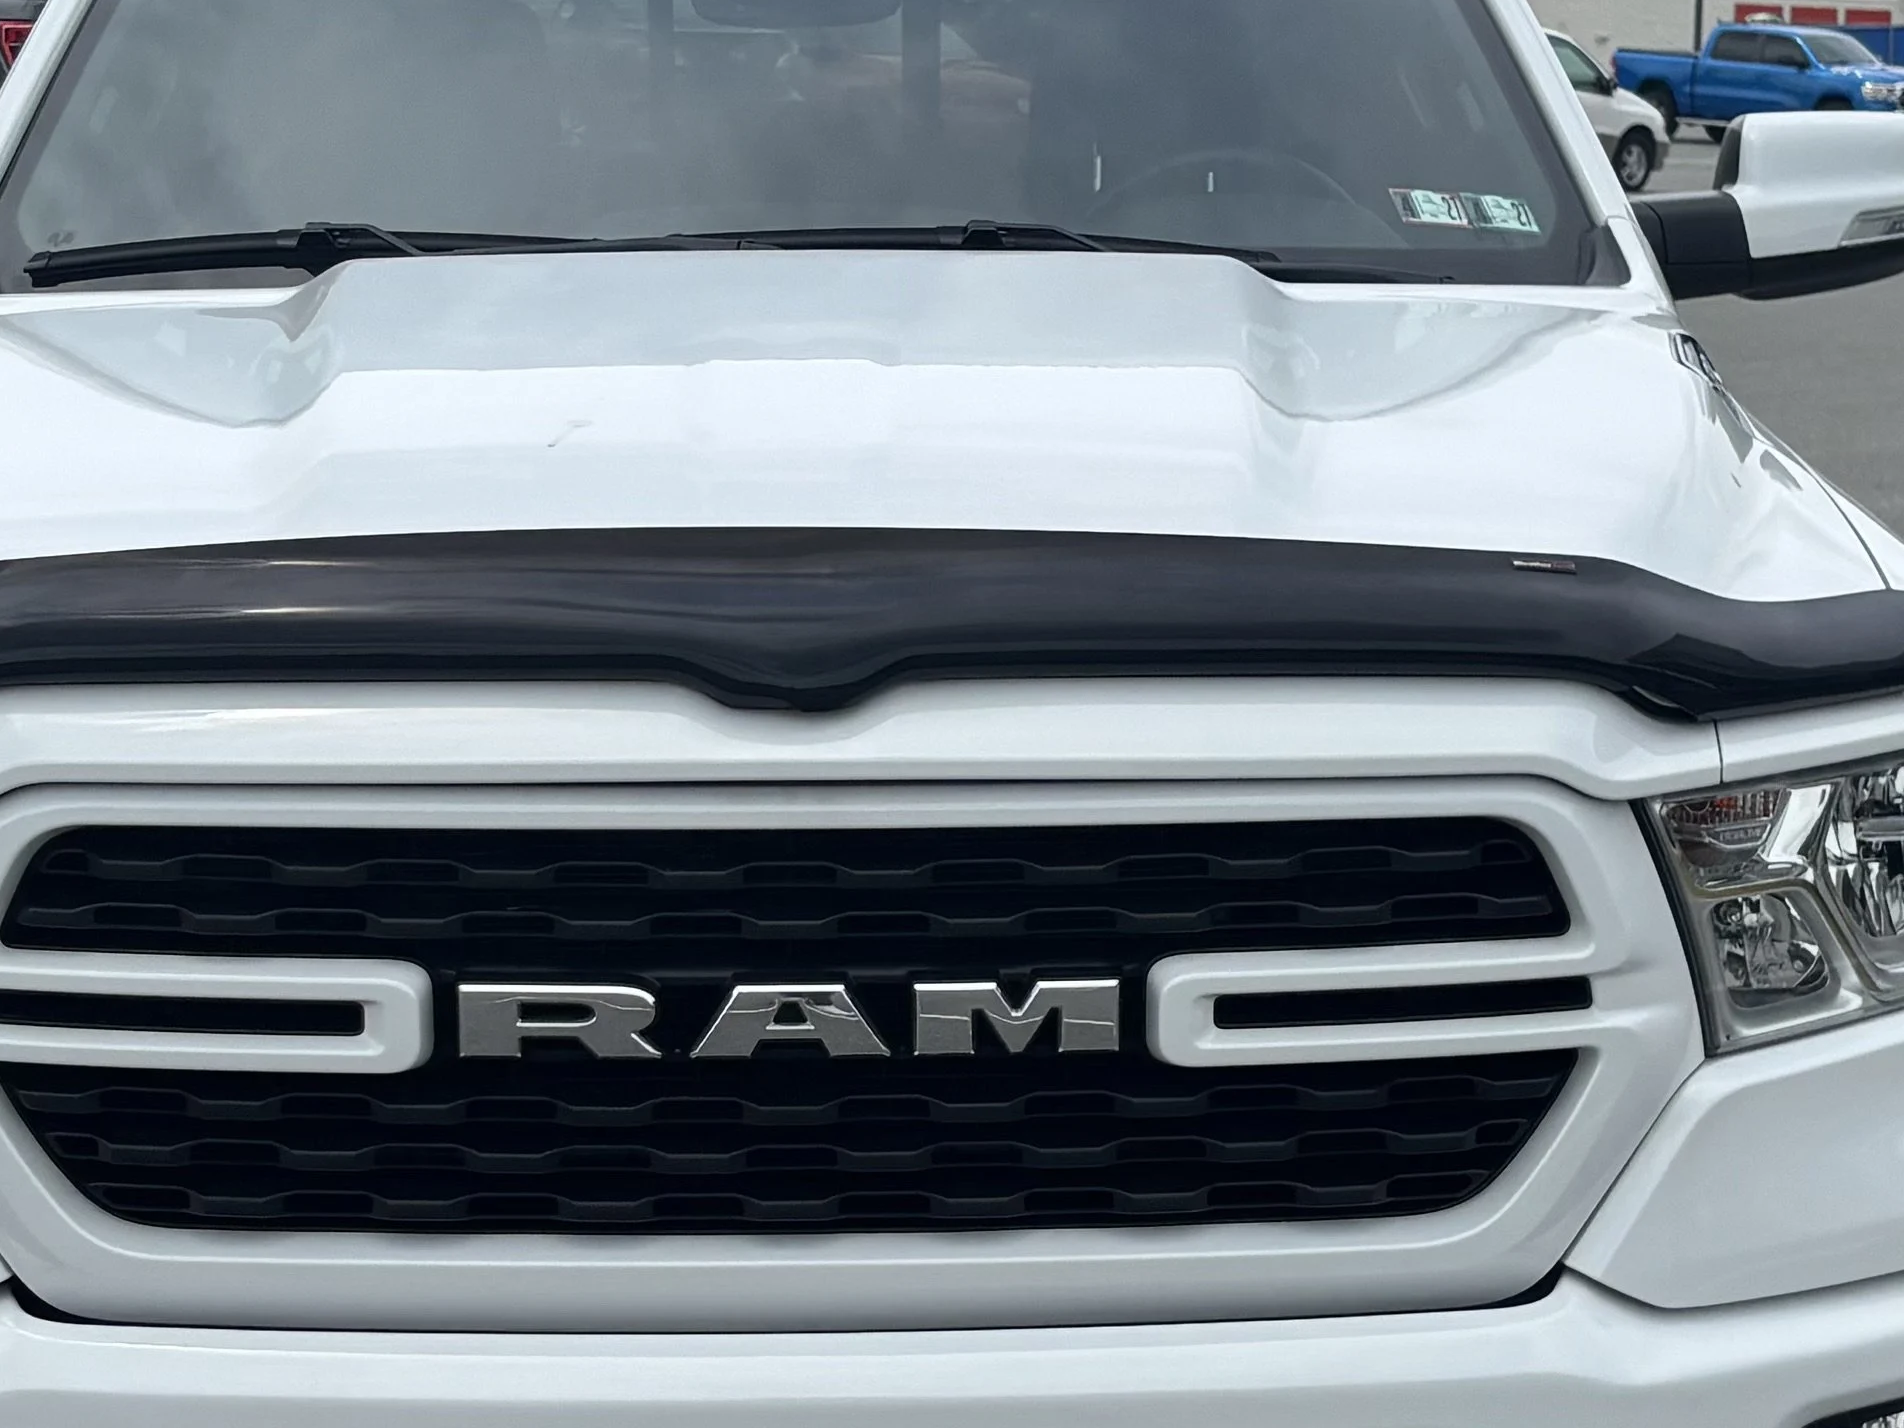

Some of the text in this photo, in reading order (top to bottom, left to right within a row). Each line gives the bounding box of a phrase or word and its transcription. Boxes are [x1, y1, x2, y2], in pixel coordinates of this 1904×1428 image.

[1442, 195, 1463, 222] 27
[1510, 202, 1534, 229] 27
[457, 978, 1121, 1058] RAM
